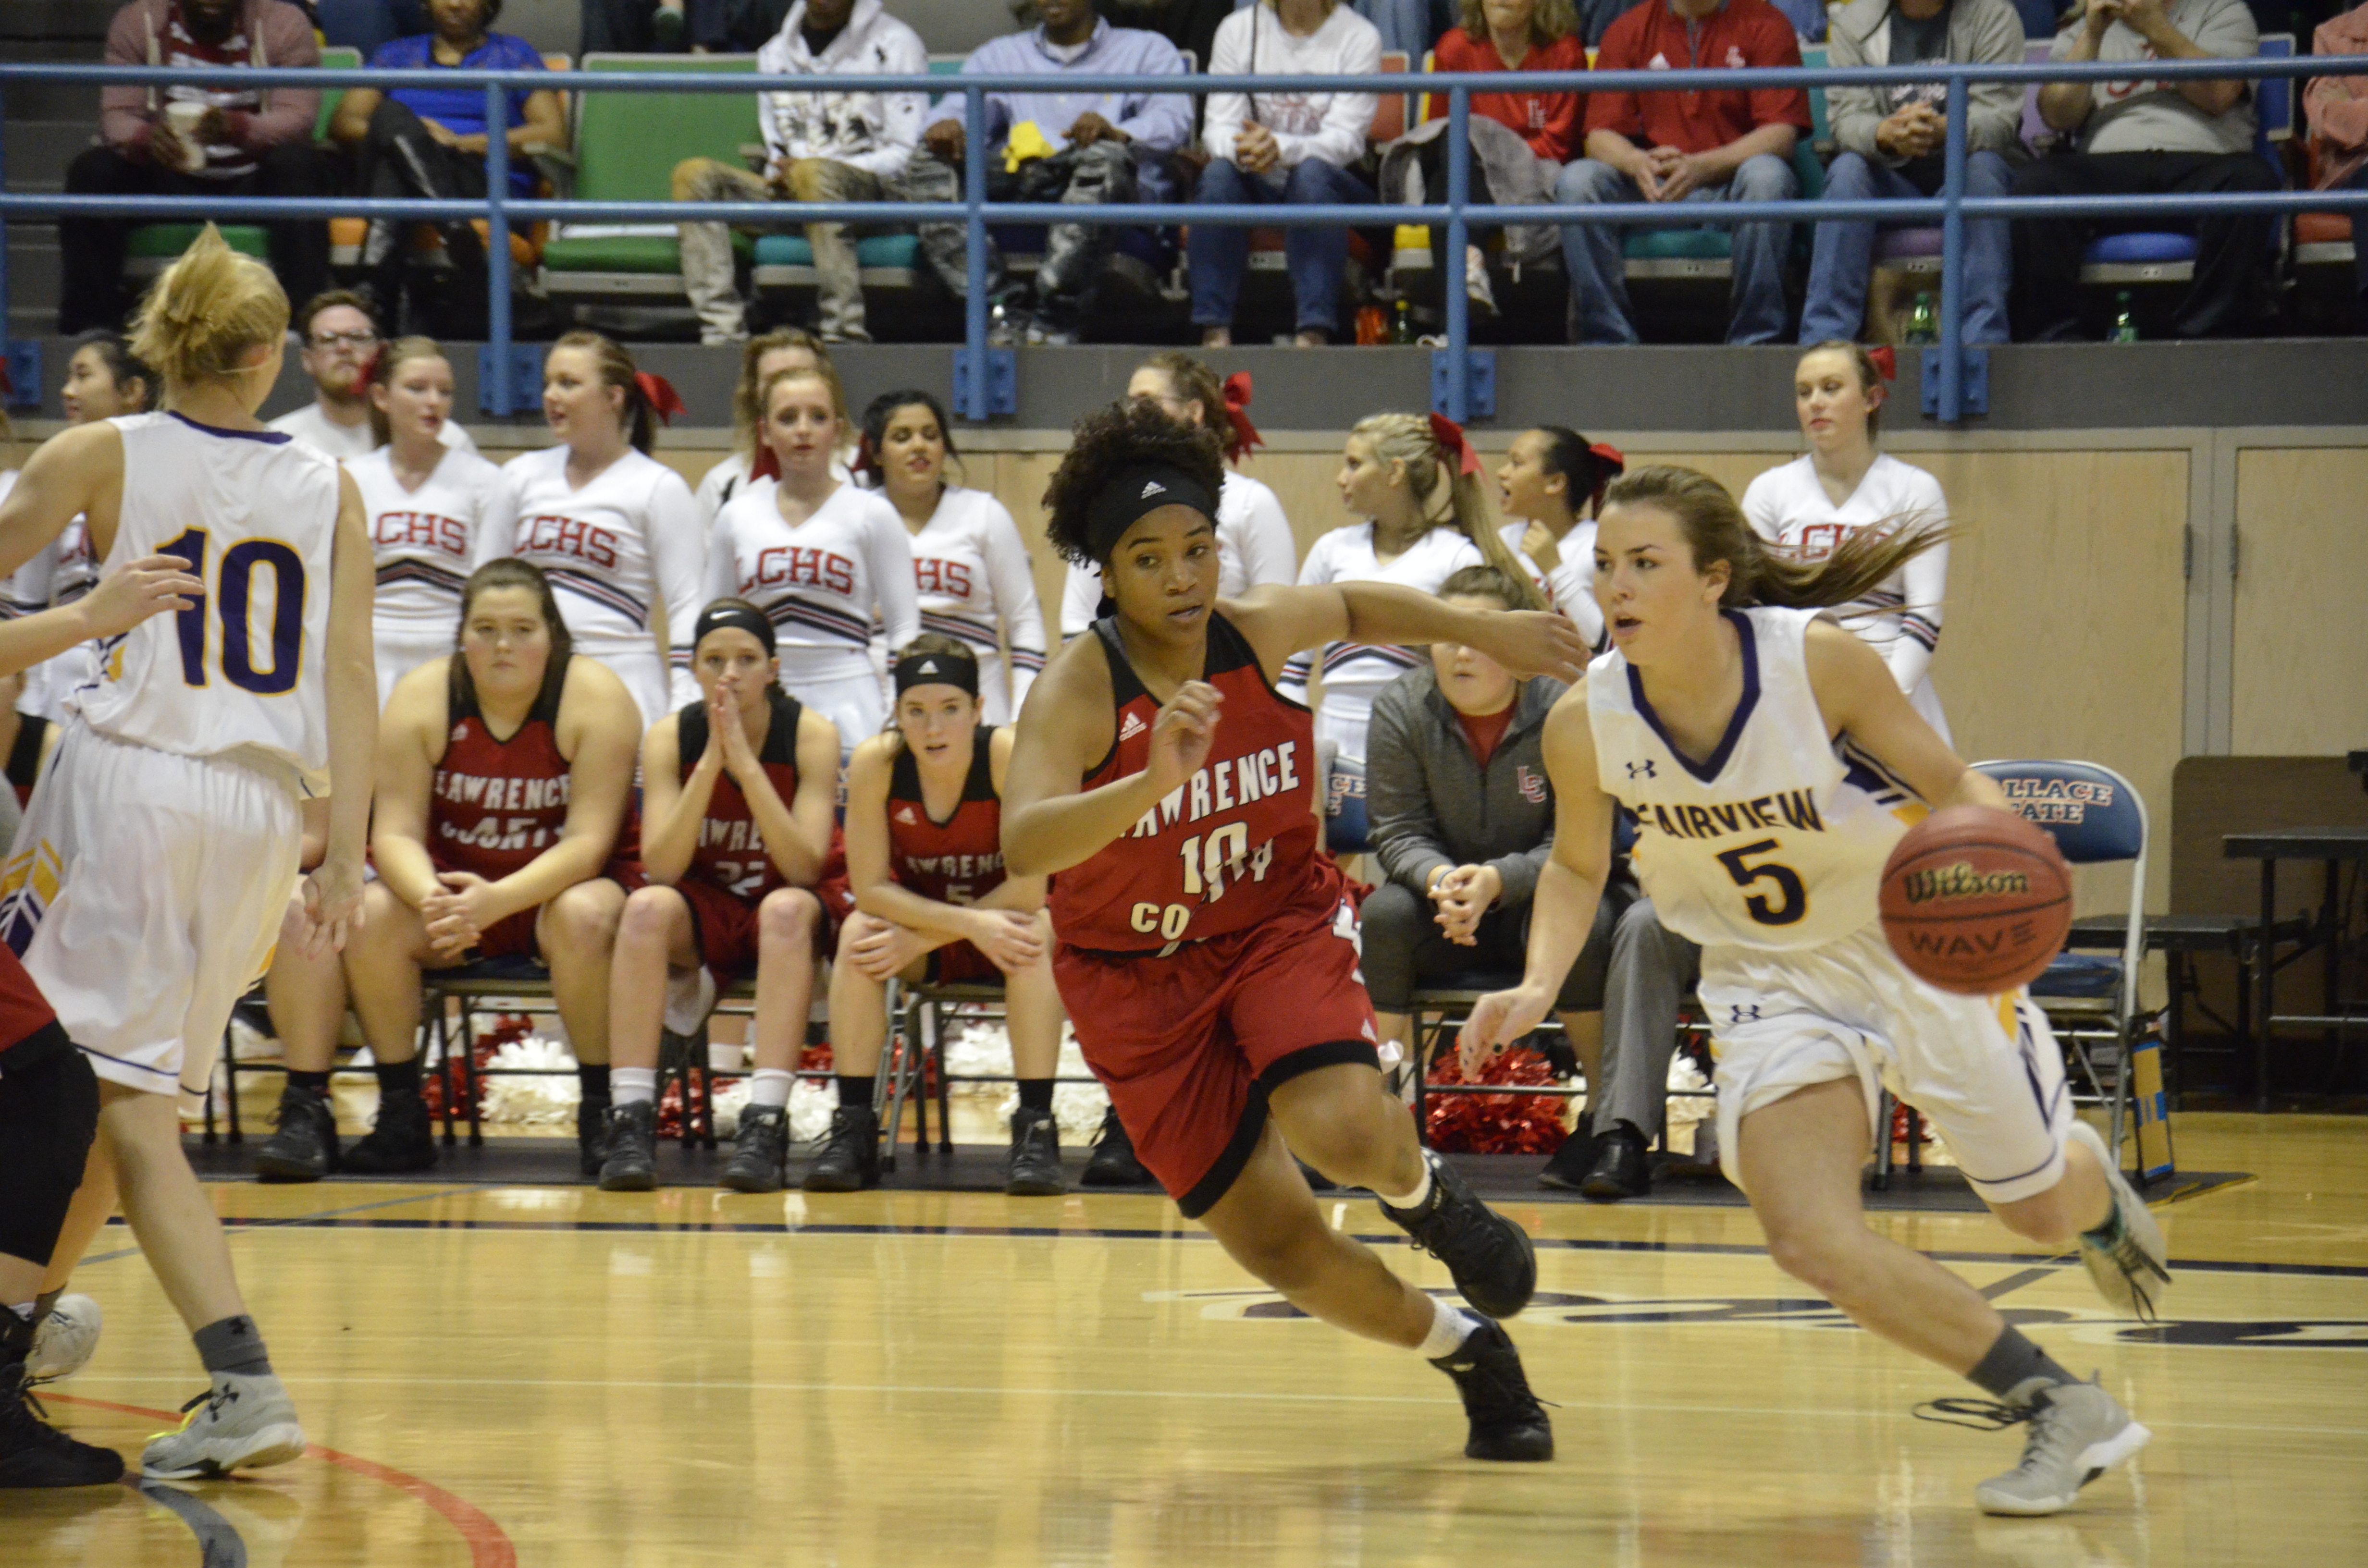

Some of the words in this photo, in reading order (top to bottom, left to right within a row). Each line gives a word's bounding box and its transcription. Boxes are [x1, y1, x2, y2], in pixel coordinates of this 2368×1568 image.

[153, 525, 308, 697] 10
[1119, 741, 1299, 839] AWRENCE
[1625, 787, 1825, 839] FAIRVIEW
[1712, 837, 1808, 927] 5
[1903, 862, 2030, 904] Wilson
[1907, 919, 2038, 956] WAVE
